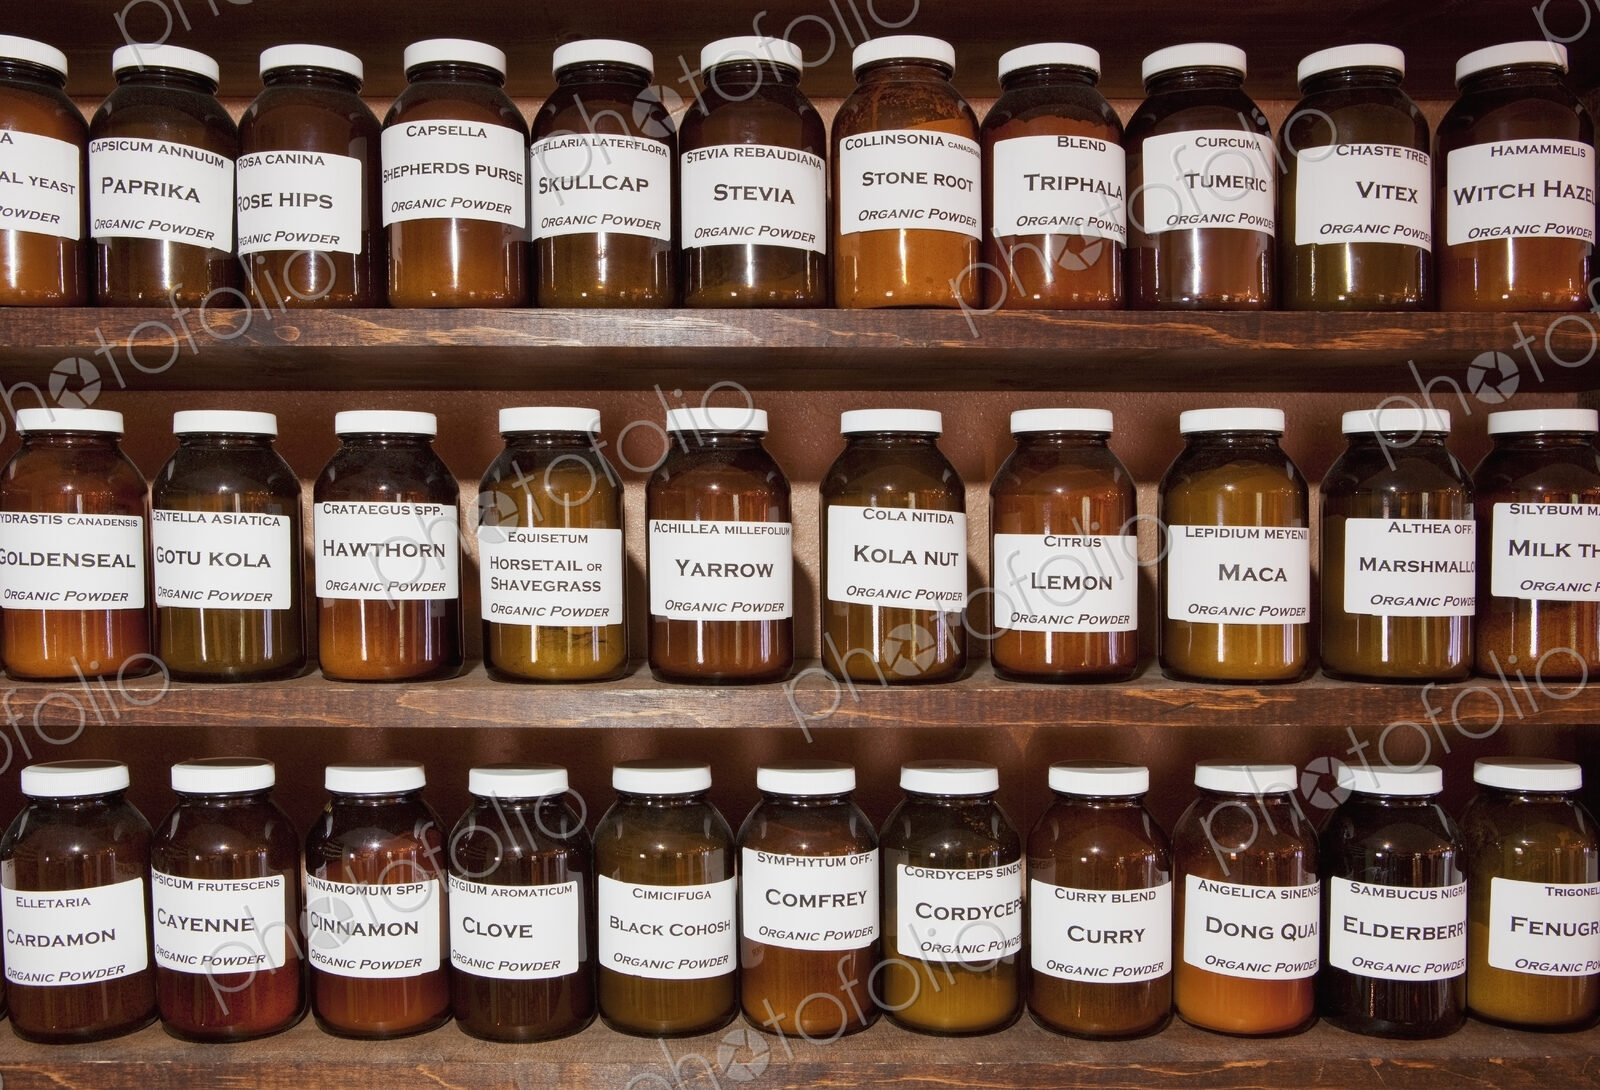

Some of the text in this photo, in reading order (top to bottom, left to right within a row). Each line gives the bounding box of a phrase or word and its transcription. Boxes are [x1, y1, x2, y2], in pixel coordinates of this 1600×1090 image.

[406, 125, 487, 139] CAPSELLA
[845, 134, 945, 151] COLLINSONIA
[1057, 136, 1107, 153] BLEND
[1490, 144, 1586, 158] HAMAMMELIS
[91, 140, 224, 169] CAPSICUM ANNUUM
[265, 154, 325, 166] CANINA
[687, 147, 822, 171] STEVIA REBAUDIANA
[1336, 145, 1428, 166] CHASTE TREE
[383, 162, 523, 186] SHEPHERDS PURSE
[862, 171, 973, 193] STONE ROOT
[1184, 172, 1267, 193] TUMERIC
[28, 175, 76, 195] YEAST
[101, 176, 201, 204] PAPRIKA
[539, 174, 649, 195] SKULLCAP
[1023, 173, 1123, 201] TRIPHALA
[1355, 181, 1418, 204] VITEX
[279, 192, 333, 209] HIPS
[713, 183, 795, 205] STEVIA
[1453, 182, 1535, 206] WITCH
[391, 197, 512, 215] ORGANIC POWDER
[541, 214, 662, 231] ORGANIC POWDER
[858, 208, 978, 228] ORGANIC POWDER
[1016, 215, 1084, 227] ORGANIC
[1166, 213, 1236, 225] ORGANIC
[94, 218, 215, 241] ORGANIC POWDER
[274, 230, 341, 245] POWDER
[694, 225, 817, 244] ORGANIC POWDER
[1319, 223, 1391, 235] ORGANIC
[1468, 222, 1593, 240] ORGANIC POWDER
[323, 503, 445, 516] CRATAEGUS SPP.
[863, 508, 954, 525] COLA NITIDA
[1509, 503, 1583, 516] SILYBUM
[67, 517, 138, 528] CANADENSIS
[211, 513, 282, 527] ASIATICA
[654, 521, 720, 534] ACHILLEA
[1388, 521, 1451, 534] ALTHEA
[508, 532, 588, 544] EQUISETUM
[1187, 526, 1260, 539] LEPIDIUM
[323, 539, 446, 558] HAWTHORN
[1043, 535, 1102, 549] CITRUS
[1508, 539, 1572, 558] MILK
[156, 546, 272, 568] GOTU KOLA
[490, 556, 603, 572] HORSETAIL OR
[854, 544, 960, 568] KOLA NUT
[675, 559, 774, 578] YARROW
[1218, 563, 1289, 582] MACA
[325, 579, 447, 592] ORGANIC POWDER
[490, 577, 602, 592] SHAVEGRASS
[1031, 572, 1112, 591] LEMON
[1520, 579, 1592, 593] ORGANIC
[4, 588, 129, 602] ORGANIC POWDER
[157, 586, 274, 602] ORGANIC POWDER
[846, 585, 963, 602] ORGANIC POWDER
[1370, 594, 1441, 607] ORGANIC
[490, 602, 610, 618] ORGANIC POWDER
[665, 599, 785, 613] ORGANIC POWDER
[1188, 603, 1307, 618] ORGANIC POWDER
[1010, 611, 1131, 625] ORGANIC POWDER
[757, 851, 874, 868] SYMPHYTUM OFF.
[904, 865, 993, 881] CORDYCEPS
[197, 878, 281, 893] FRUTESCENS
[396, 883, 427, 895] SPP.
[491, 885, 571, 898] AROMATICUM
[1198, 879, 1277, 900] ANGELICA
[1350, 882, 1438, 900] SAMBUCUS
[16, 896, 92, 909] ELLETARIA
[632, 887, 713, 902] CIMICIFUGA
[765, 888, 868, 908] COMFREY
[1054, 887, 1157, 904] CURRY BLEND
[157, 908, 256, 933] CAYENNE
[310, 911, 419, 937] CINNAMON
[462, 916, 533, 938] CLOVE
[610, 915, 732, 937] BLACK COHOSH
[1205, 915, 1274, 940] DONG
[7, 928, 116, 948] CARDAMON
[759, 926, 874, 941] ORGANIC POWDER
[1067, 925, 1145, 944] CURRY
[920, 941, 985, 954] ORGANIC
[310, 949, 422, 971] ORGANIC POWDER
[451, 949, 561, 972] ORGANIC POWDER
[613, 952, 729, 971] ORGANIC POWDER
[1045, 959, 1165, 978] ORGANIC POWDER
[1205, 955, 1318, 974] ORGANIC POWDER
[1352, 956, 1466, 974] ORGANIC POWDER
[1515, 958, 1585, 972] ORGANIC
[58, 963, 127, 983] POWDER
